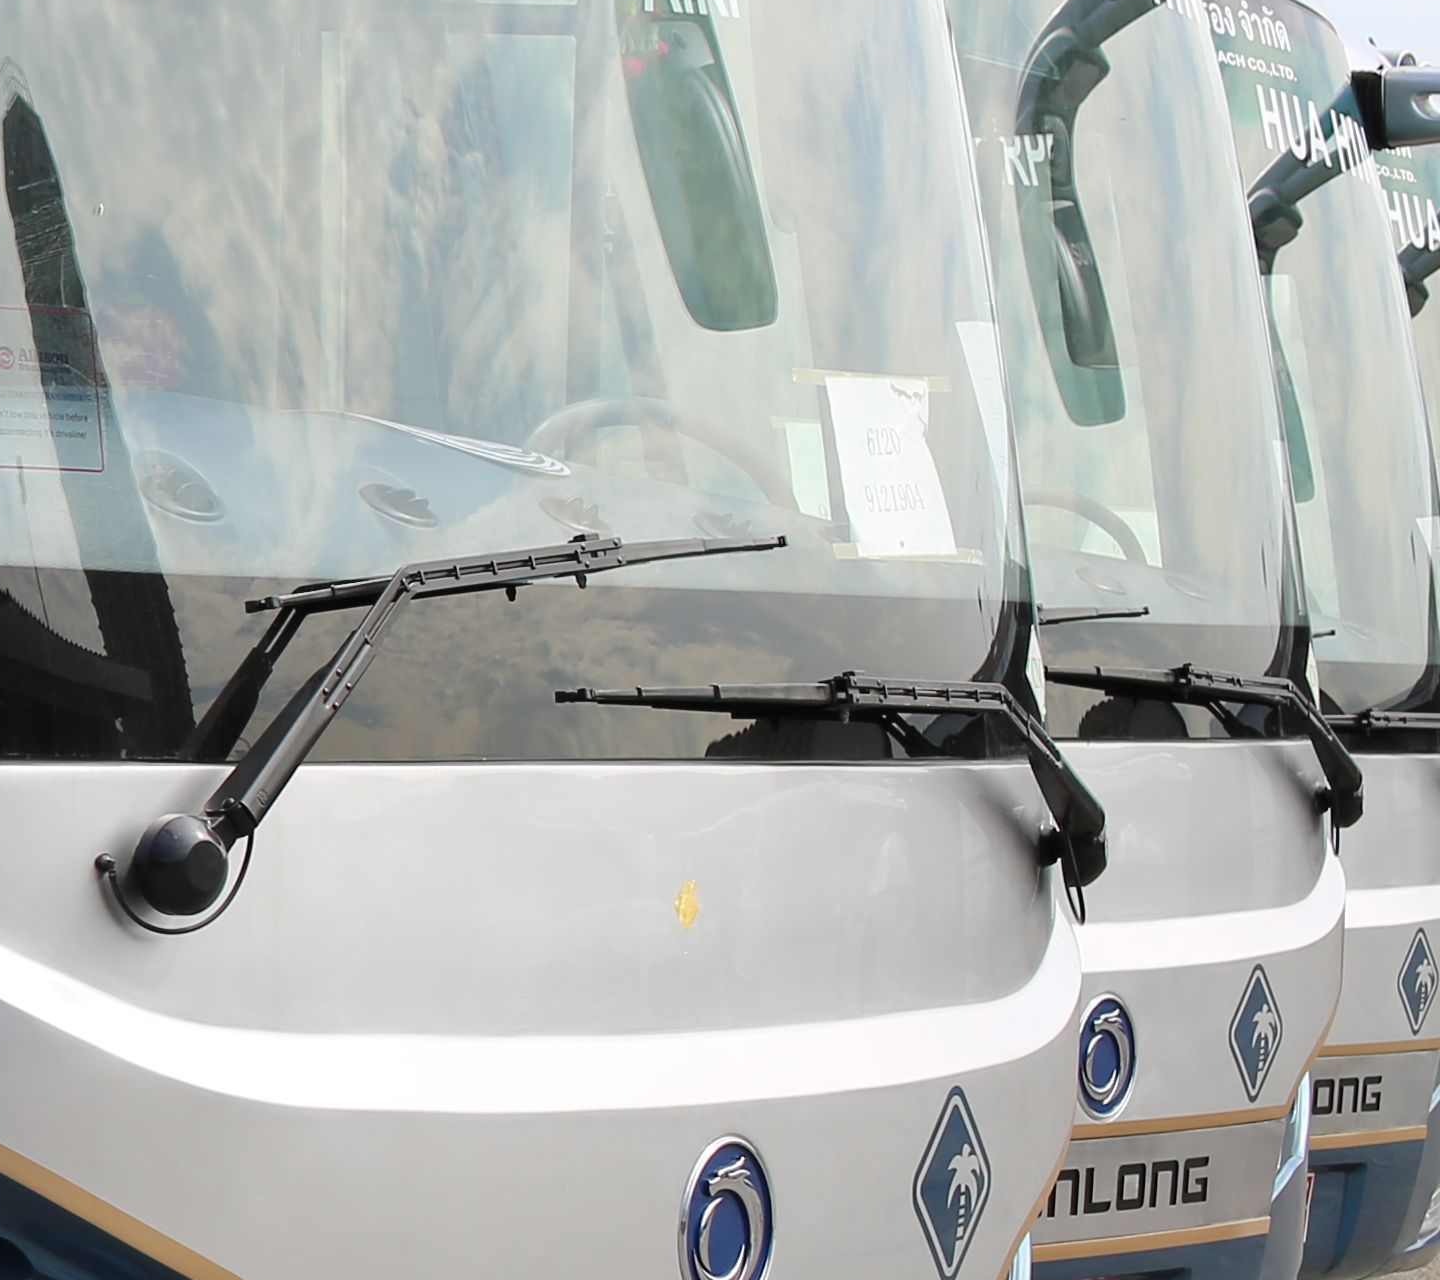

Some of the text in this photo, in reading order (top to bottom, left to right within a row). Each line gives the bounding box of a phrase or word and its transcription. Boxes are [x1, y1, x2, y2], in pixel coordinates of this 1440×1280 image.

[1238, 0, 1293, 53] จำกัด
[1256, 83, 1333, 169] HUA
[866, 427, 902, 456] 6120
